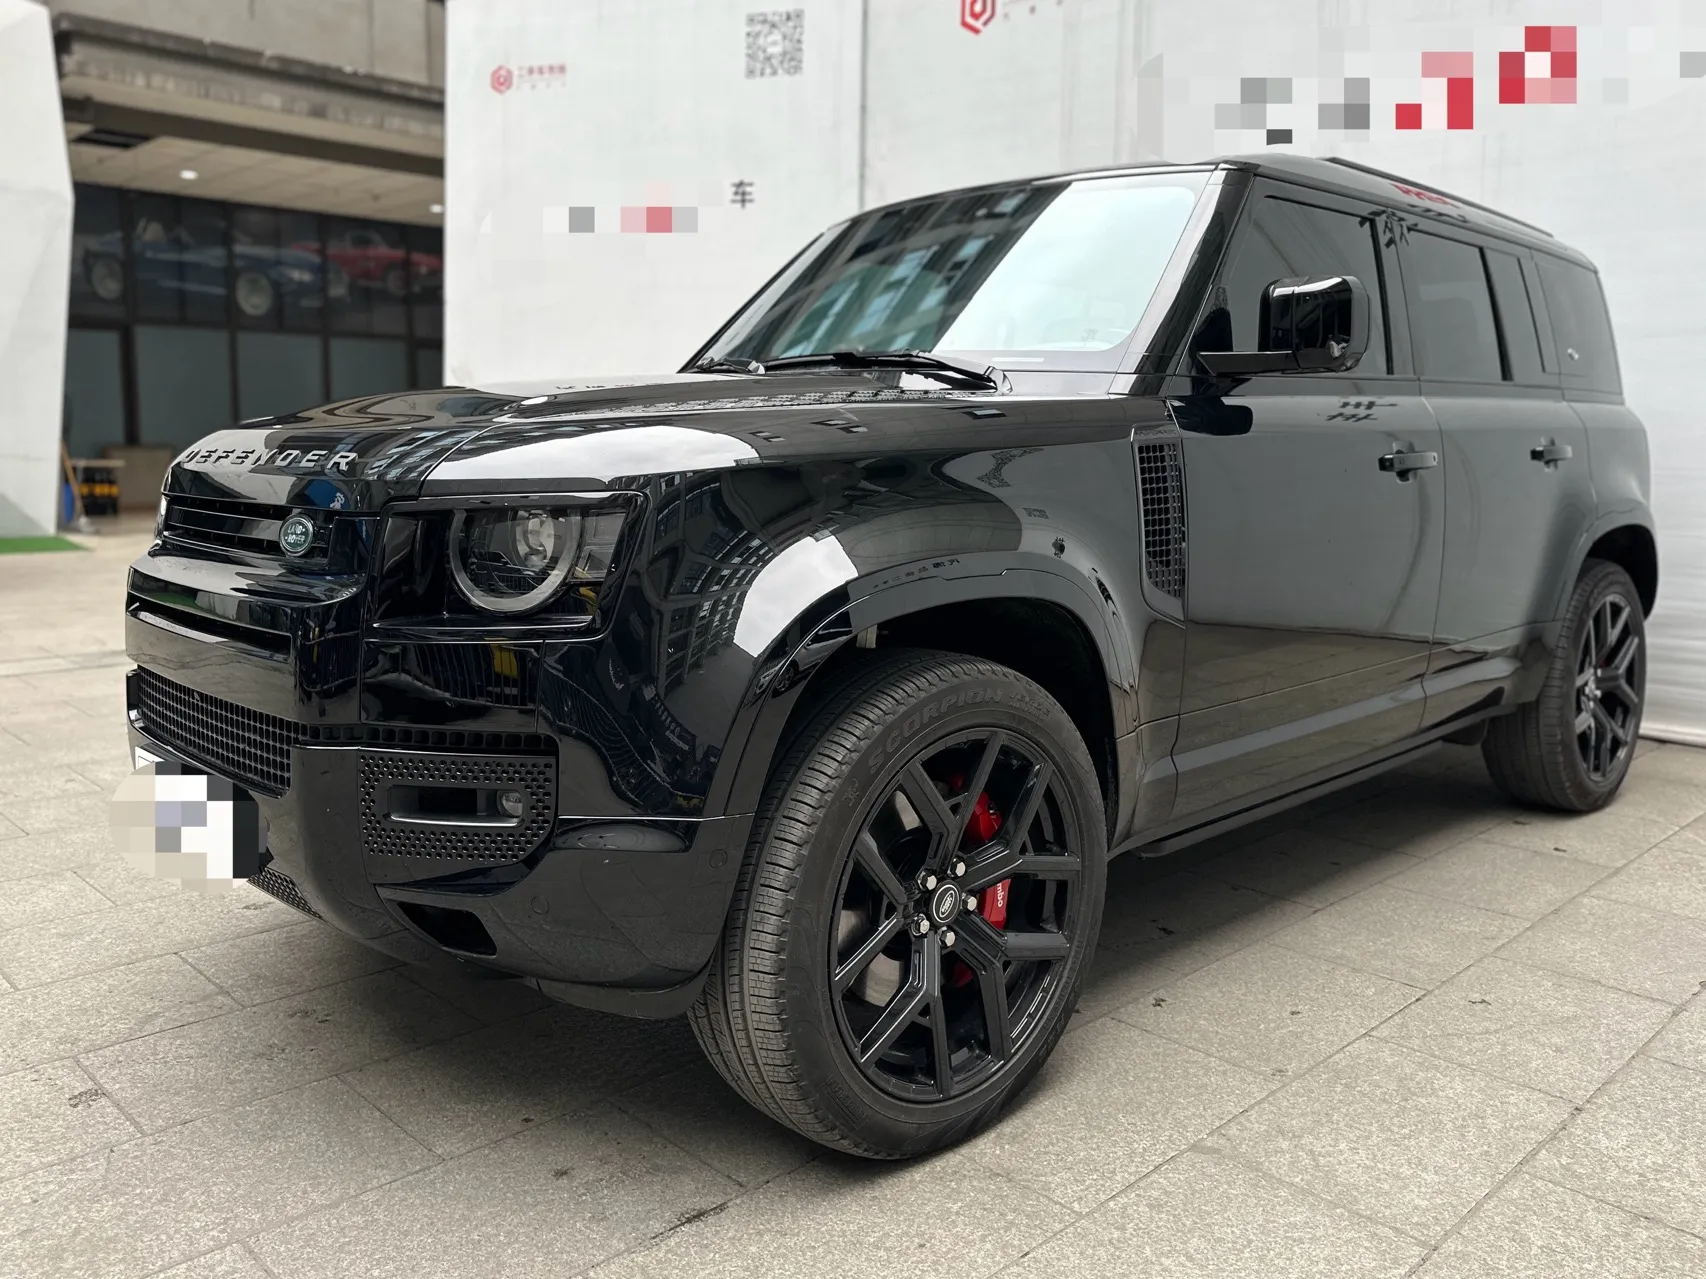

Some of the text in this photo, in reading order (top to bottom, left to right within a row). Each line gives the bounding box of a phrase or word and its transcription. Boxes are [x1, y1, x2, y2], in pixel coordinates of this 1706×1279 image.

[730, 179, 755, 210] 车
[181, 449, 358, 471] DEFENDER
[868, 688, 1003, 774] SCORPION
